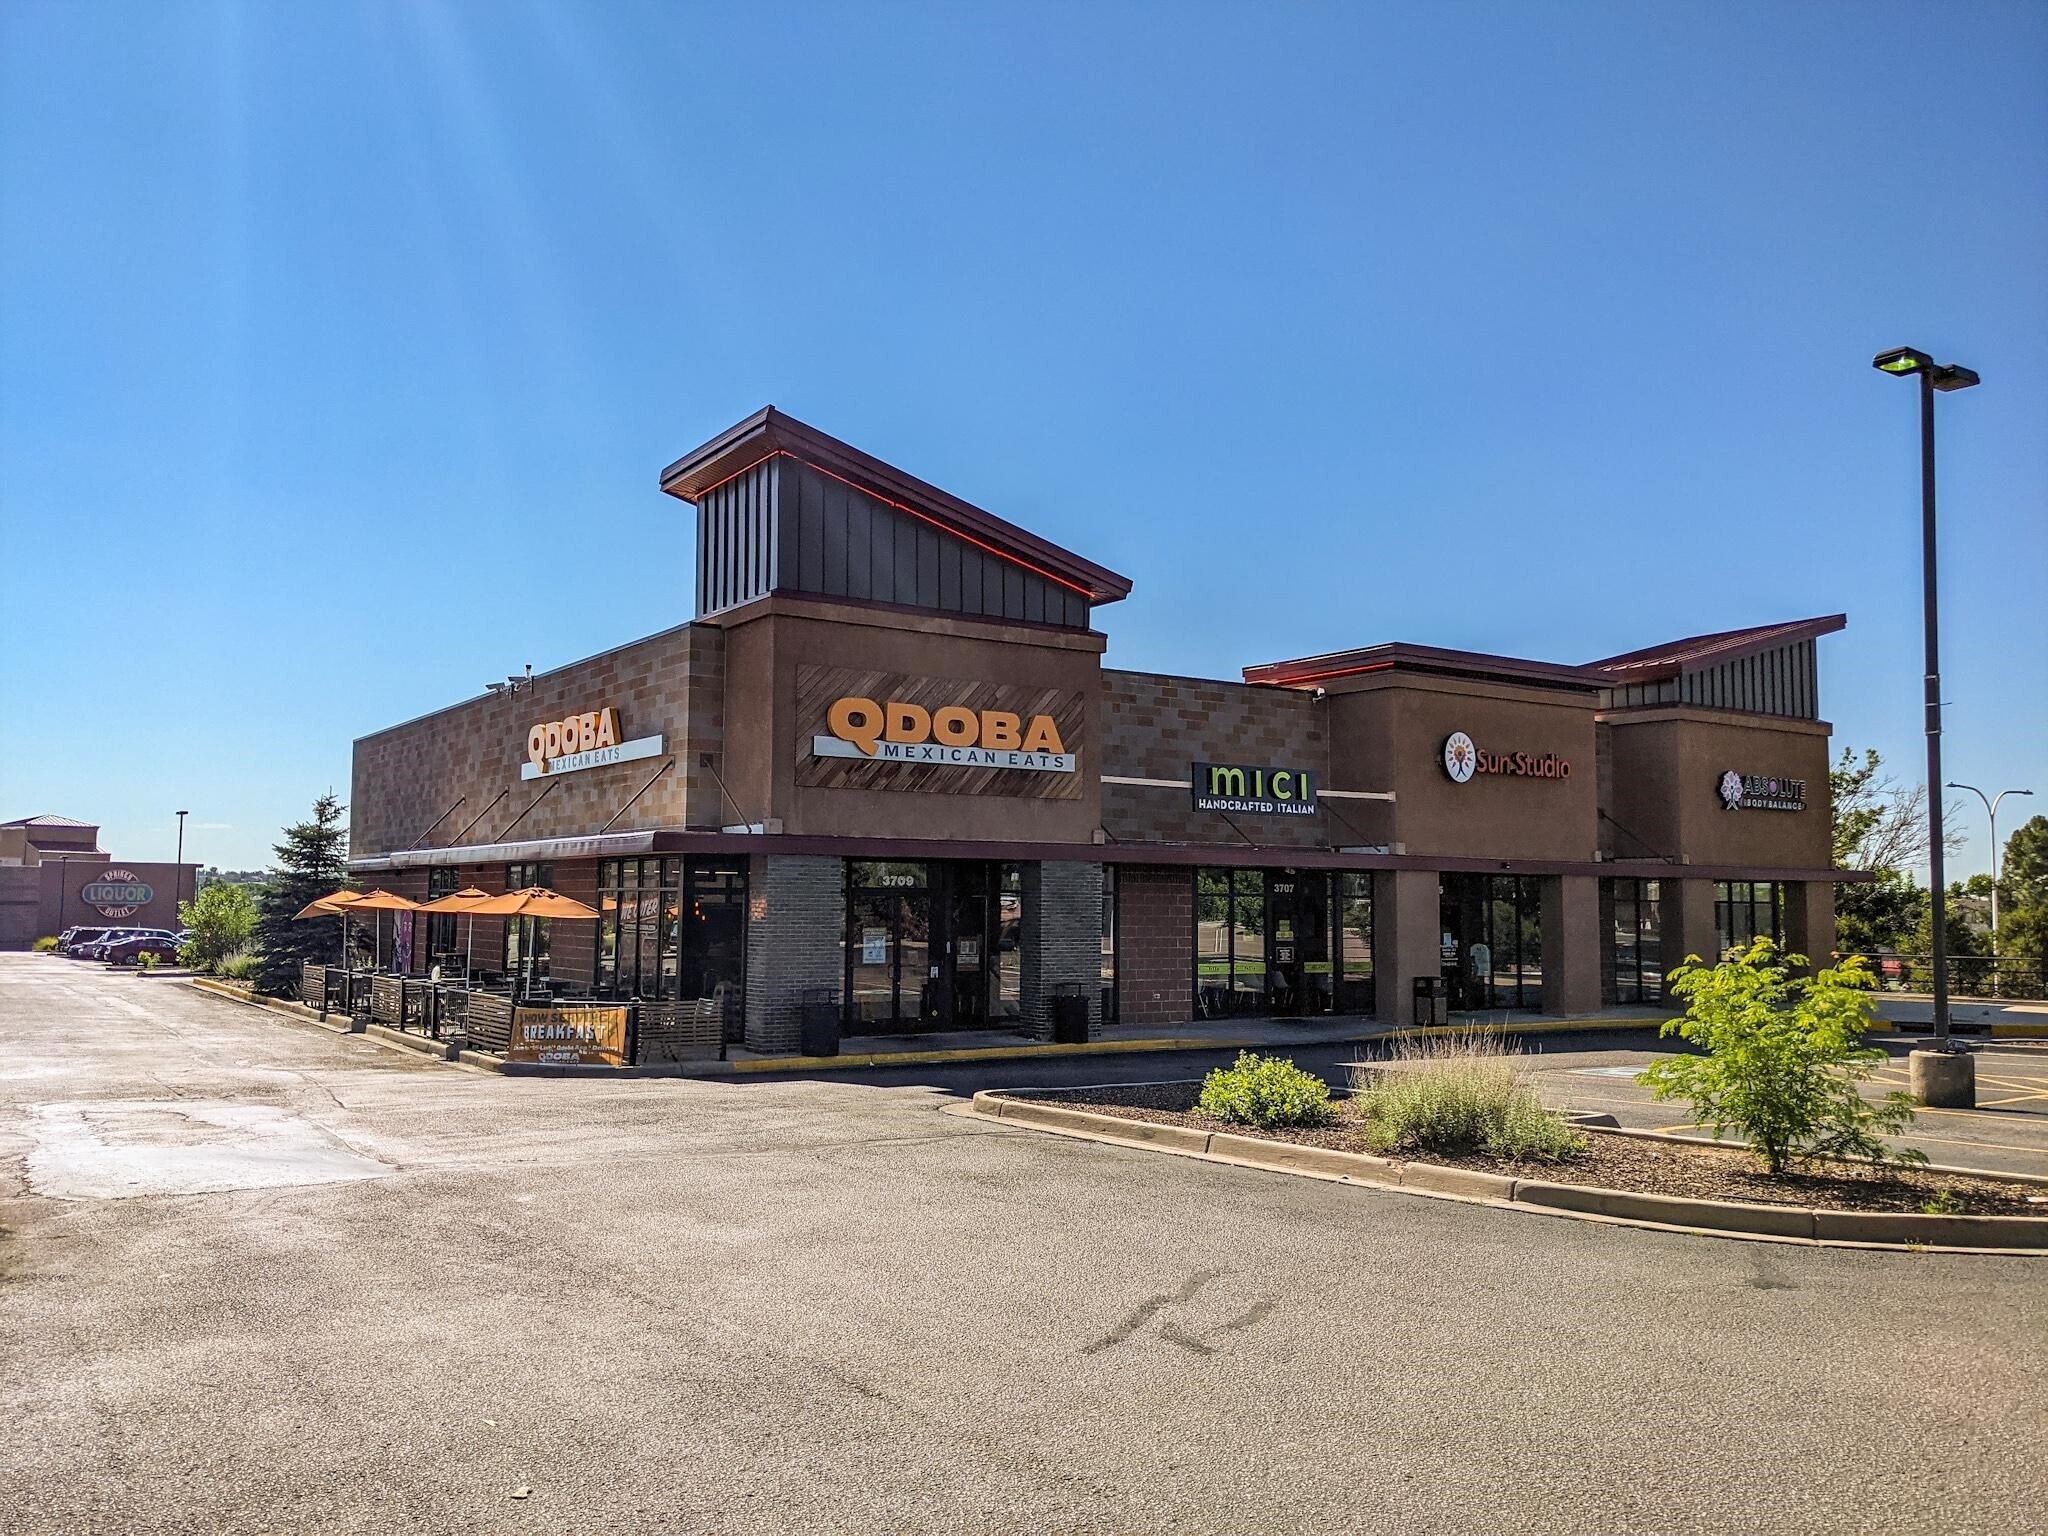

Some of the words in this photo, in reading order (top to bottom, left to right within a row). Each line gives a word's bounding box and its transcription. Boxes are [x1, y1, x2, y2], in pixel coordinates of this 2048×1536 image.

[827, 697, 1065, 756] QDOBA
[528, 707, 620, 773] QDOBA
[548, 752, 591, 772] MEXICAN
[594, 747, 620, 763] EATS
[884, 744, 996, 764] MEXICAN
[1009, 753, 1064, 768] EATS
[1476, 748, 1511, 773] Sun
[1515, 751, 1571, 778] Studio
[1743, 775, 1807, 798] ABSOLUTE
[1198, 798, 1273, 812] HANDCRAFTED
[1277, 803, 1315, 814] ITALIAN
[1747, 799, 1767, 808] BODY
[1768, 800, 1802, 811] BALANCE
[882, 875, 914, 886] 3709
[1273, 883, 1295, 893] 3707
[90, 886, 146, 901] LIQUOR
[523, 1013, 548, 1023] NOW
[523, 1024, 606, 1040] BREAKFAST
[538, 1052, 580, 1062] QDOBA
